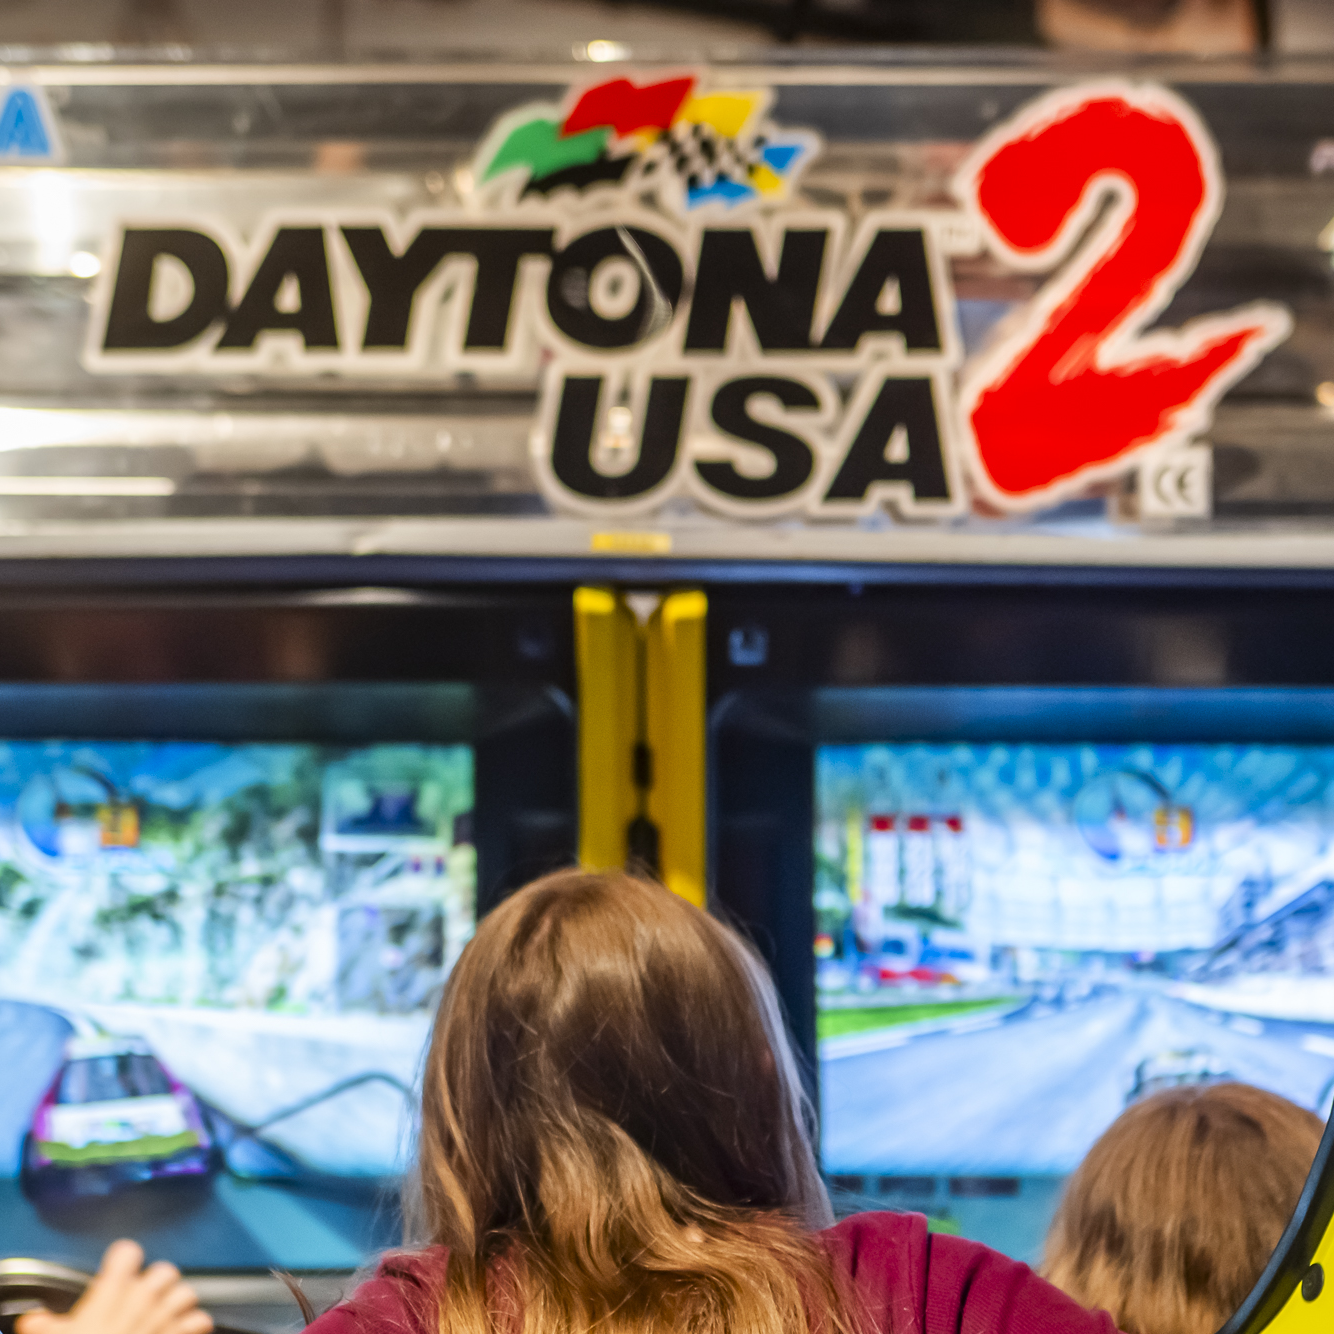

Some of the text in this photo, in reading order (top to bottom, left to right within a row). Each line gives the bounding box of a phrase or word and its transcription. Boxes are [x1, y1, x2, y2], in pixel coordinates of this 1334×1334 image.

[100, 224, 942, 354] DAYTONA
[549, 94, 1267, 501] USA 2
